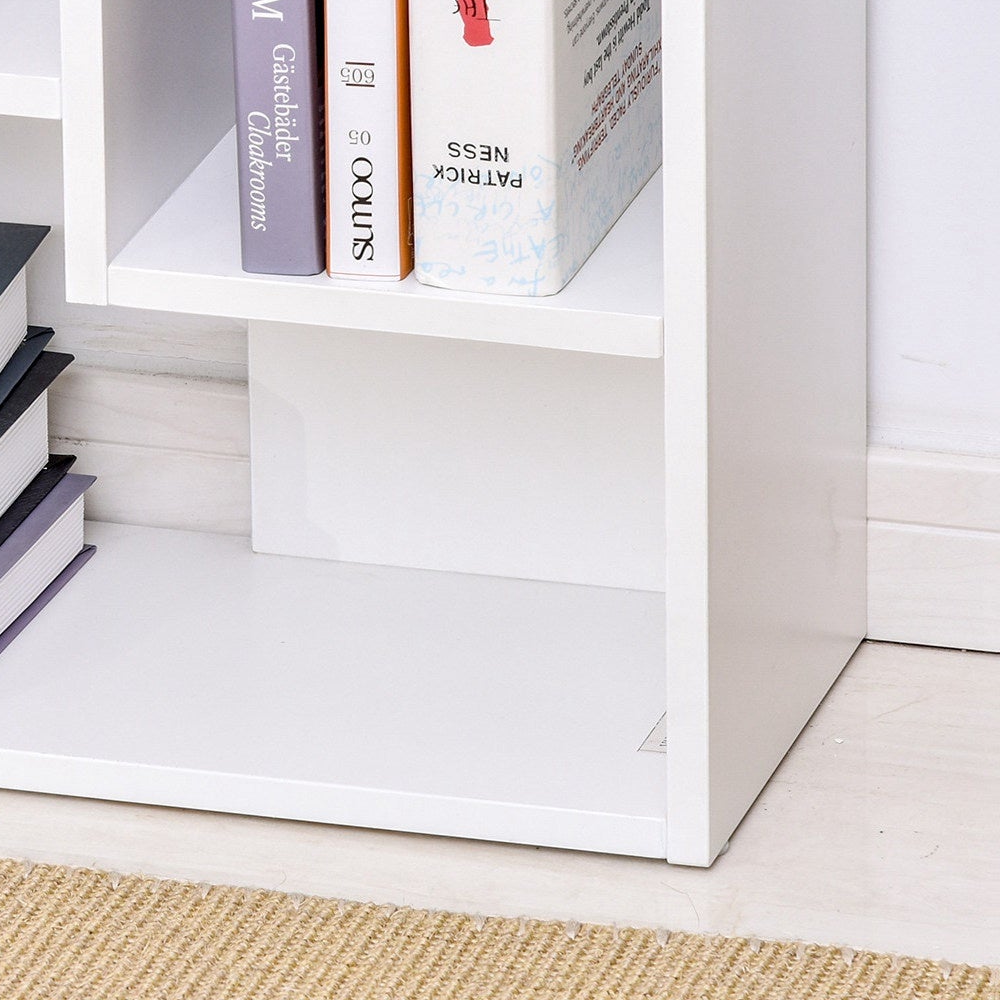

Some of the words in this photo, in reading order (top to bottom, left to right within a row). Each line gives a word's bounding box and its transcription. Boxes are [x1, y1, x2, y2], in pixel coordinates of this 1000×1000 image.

[340, 67, 375, 83] 605
[272, 43, 299, 163] Gästebäder
[348, 130, 371, 146] 05
[447, 142, 509, 163] NESS
[247, 110, 273, 232] Cloakrooms
[432, 164, 523, 188] PATRICK
